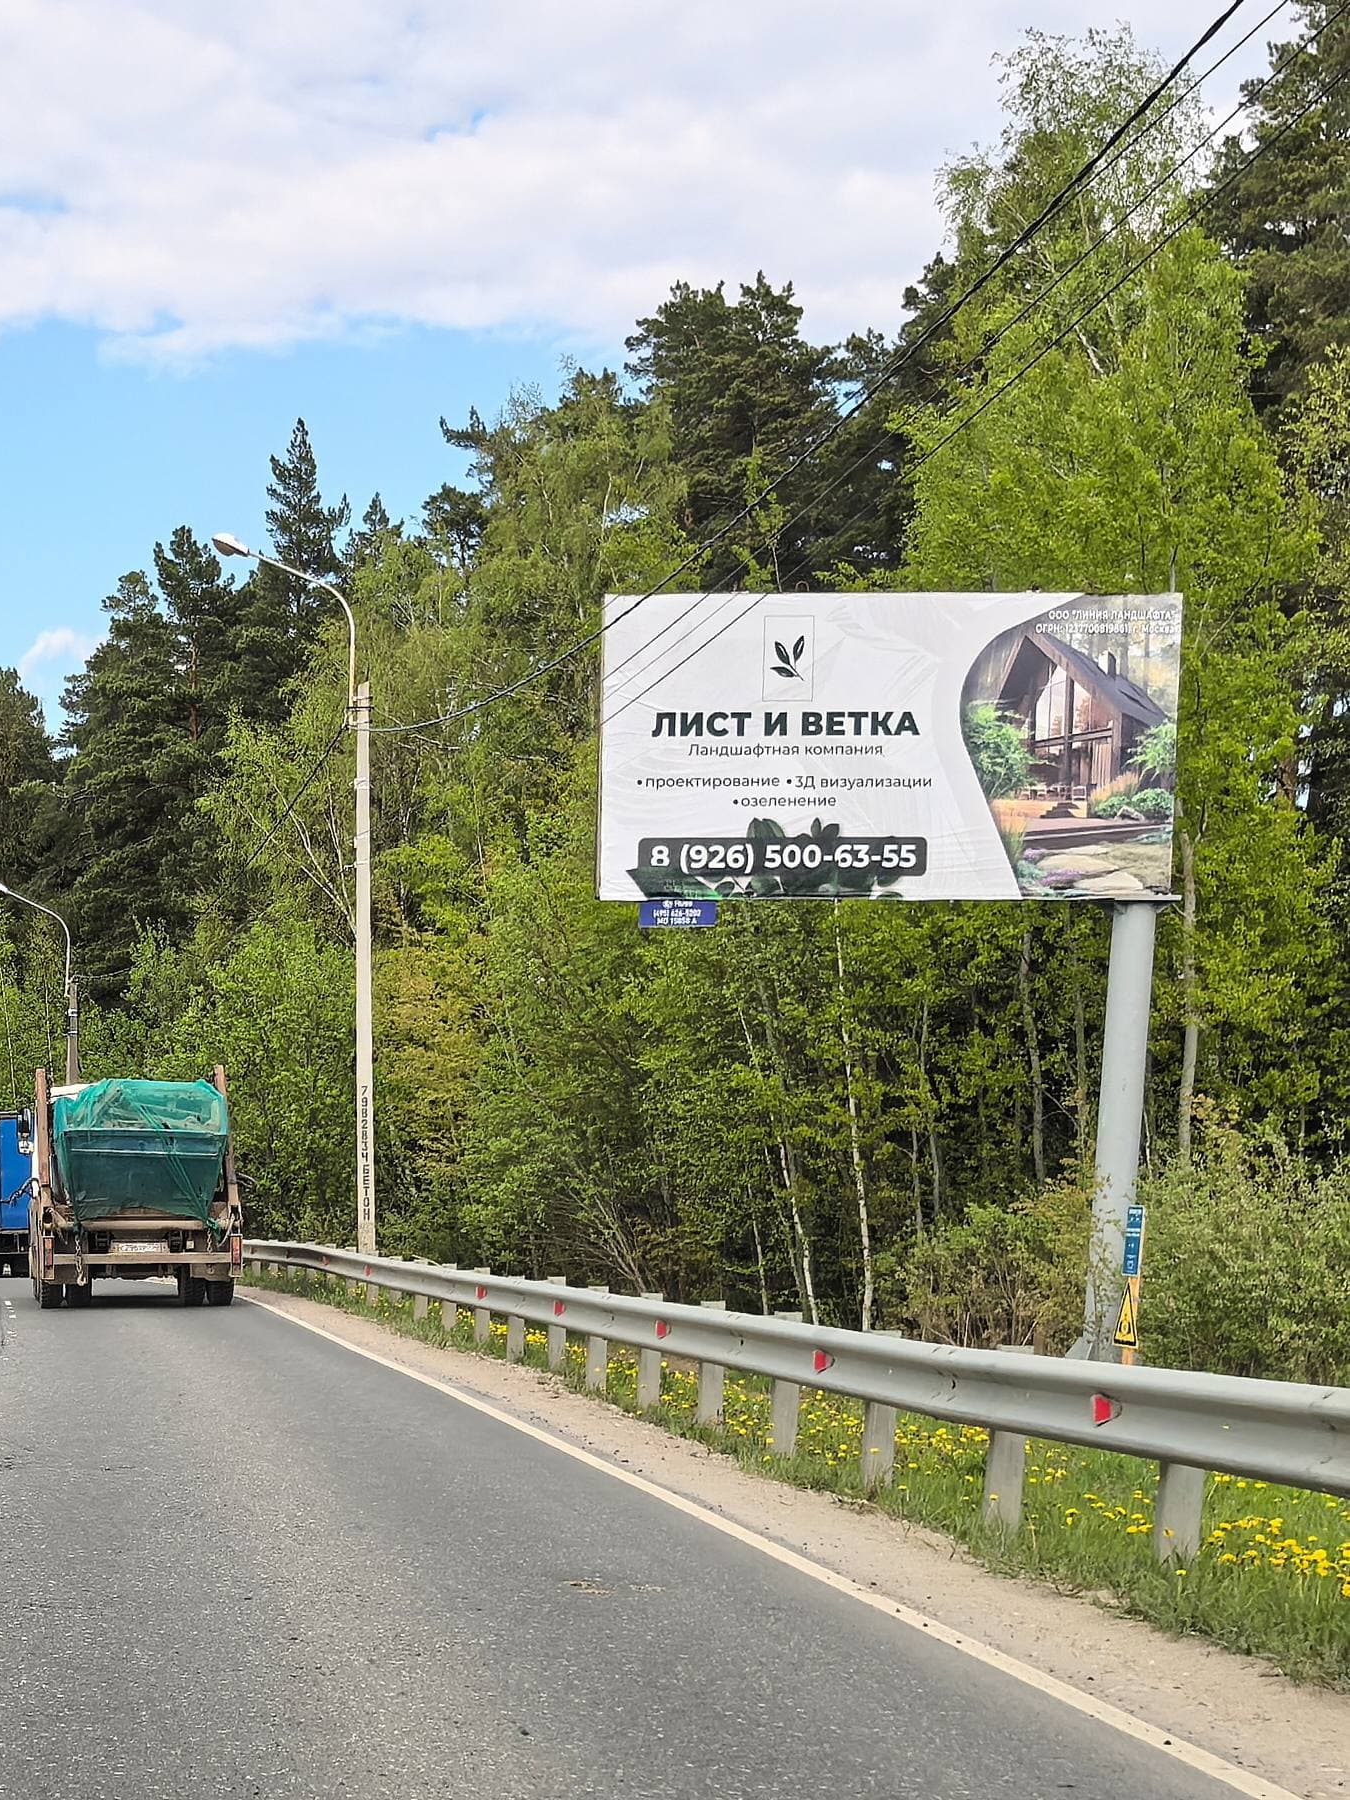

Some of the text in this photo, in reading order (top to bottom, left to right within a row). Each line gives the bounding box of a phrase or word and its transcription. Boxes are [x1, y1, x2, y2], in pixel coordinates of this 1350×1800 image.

[1048, 610, 1070, 620] ООО
[651, 711, 921, 738] ЛИСТ И ВЕТКА
[688, 743, 883, 758] Ландшафтная компания
[645, 776, 780, 789] проектирование
[820, 776, 933, 790] визуализации
[741, 795, 837, 807] озеленение
[650, 843, 917, 873] 8 (926) 500-63-55
[362, 1164, 371, 1221] БЕТОН
